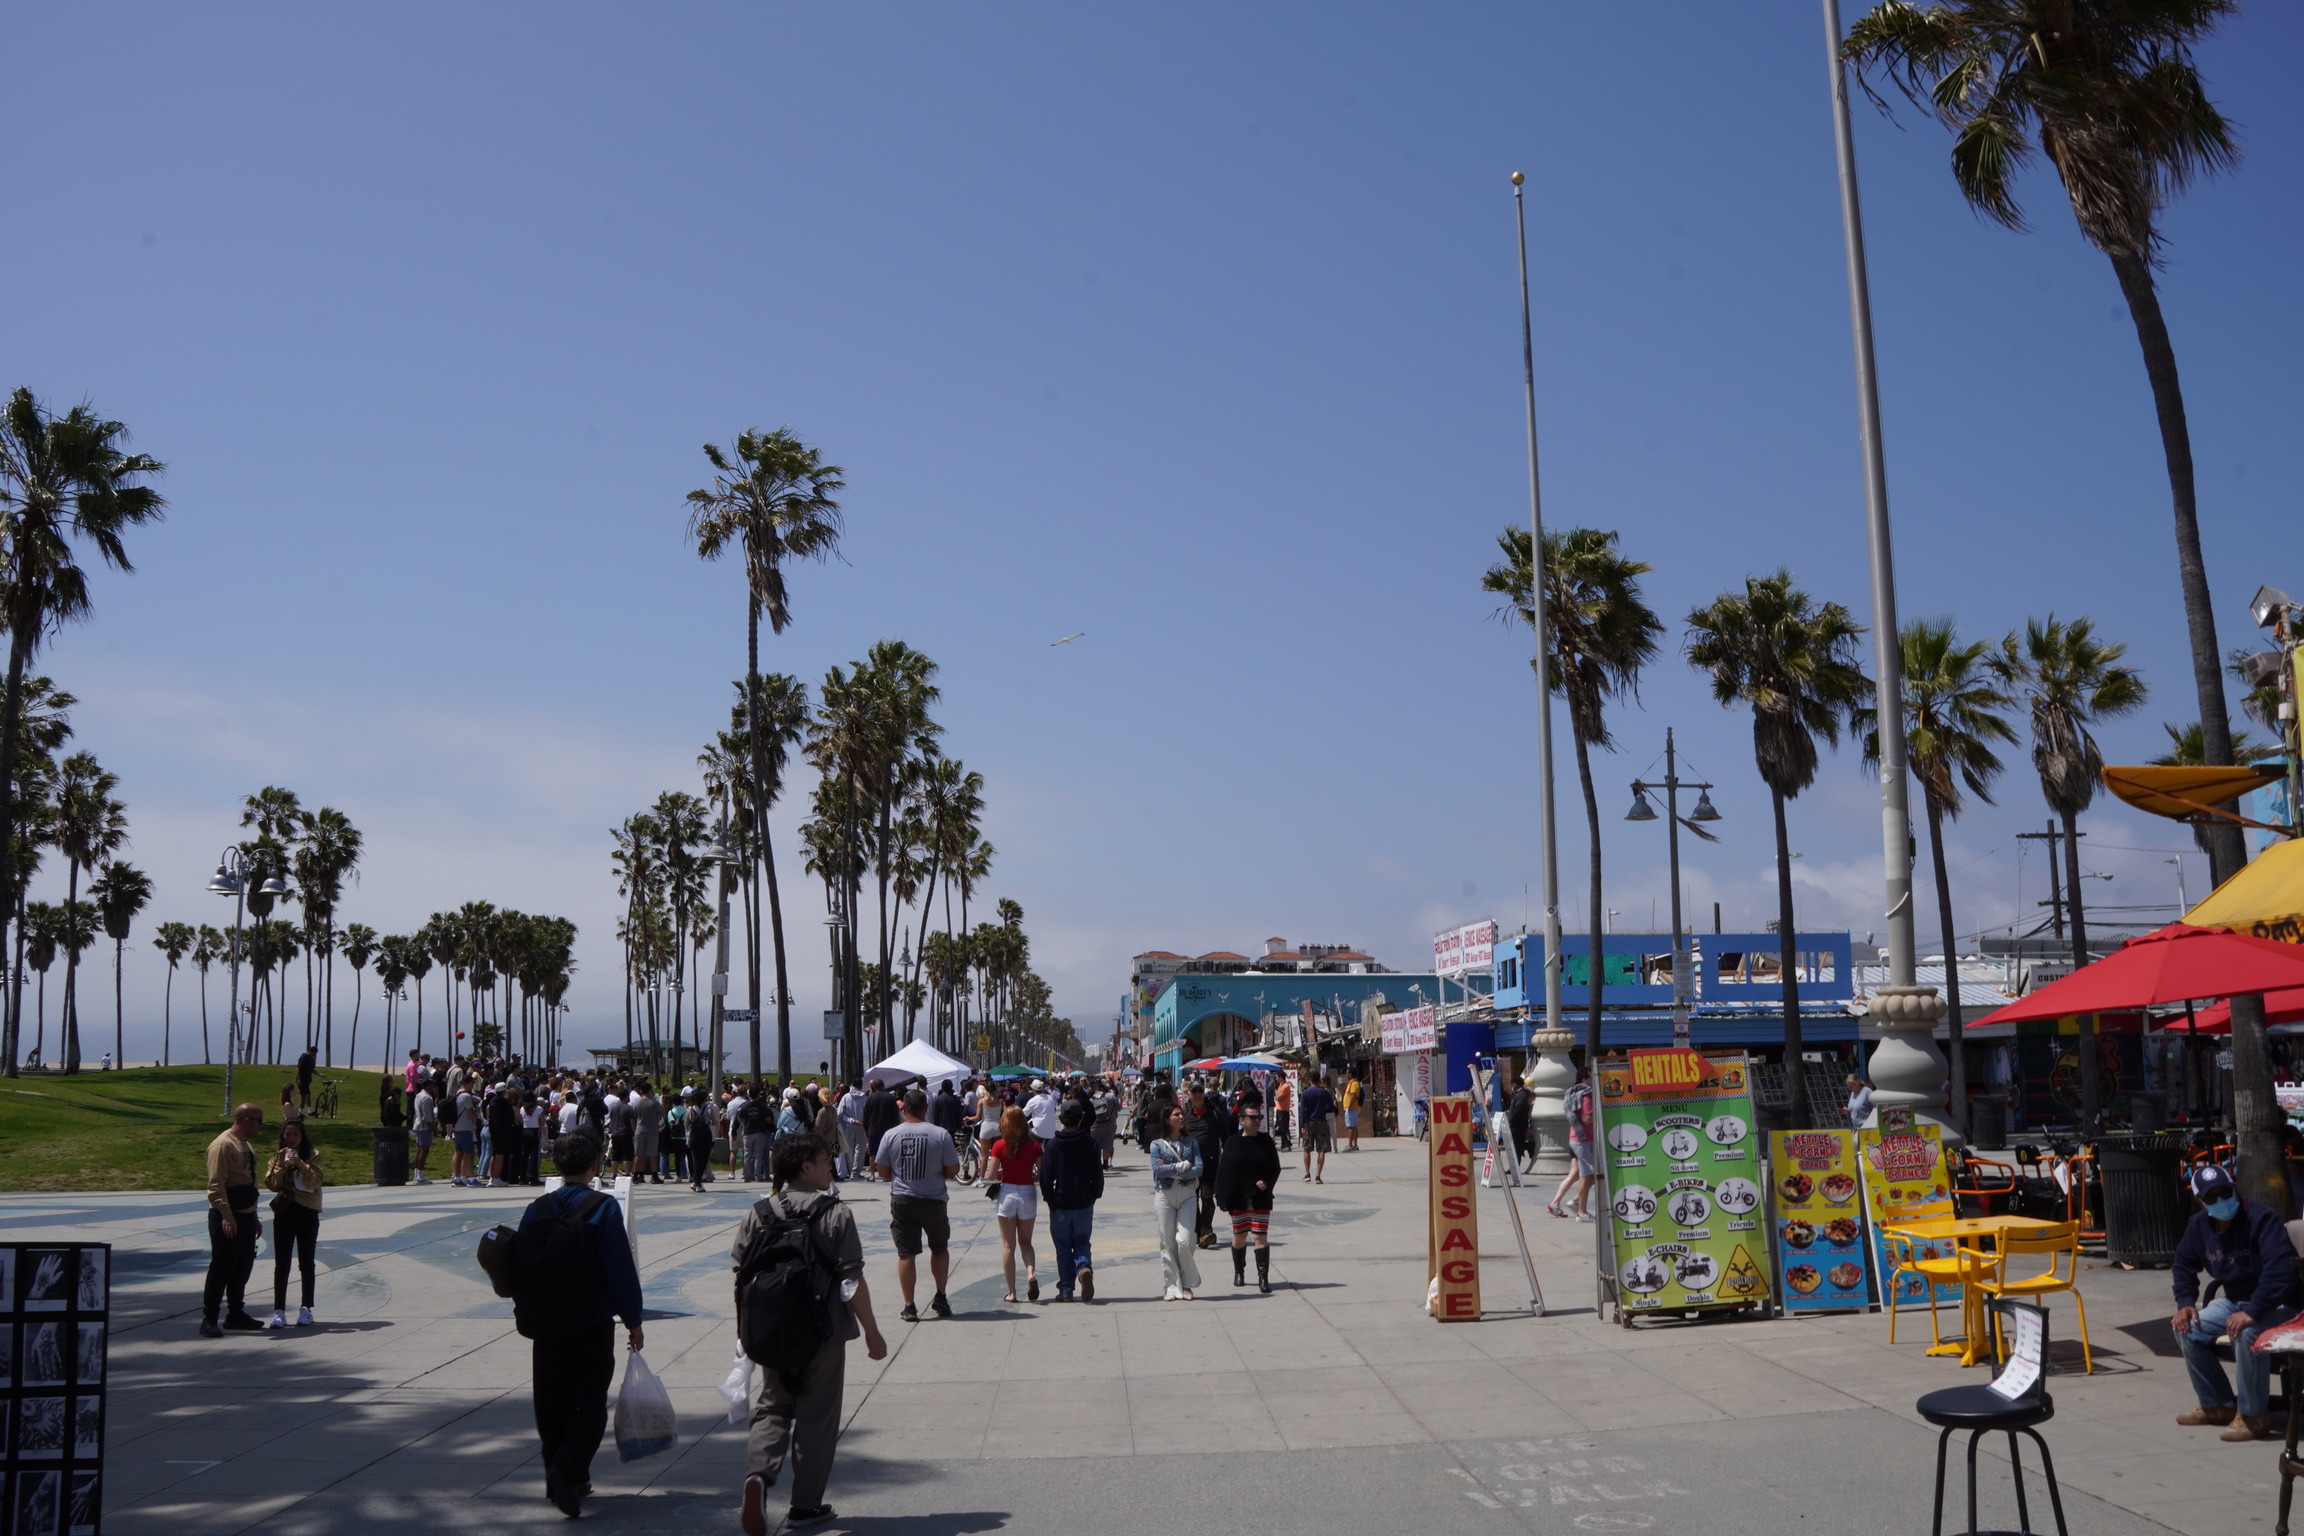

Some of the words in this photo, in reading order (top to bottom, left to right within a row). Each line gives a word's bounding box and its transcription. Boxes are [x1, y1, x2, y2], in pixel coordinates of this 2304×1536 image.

[2038, 974, 2067, 982] CUST
[1633, 1053, 1700, 1085] RENTALS
[1415, 1048, 1430, 1102] MASSA
[1662, 1104, 1687, 1113] MENU
[1656, 1117, 1700, 1127] SCOOTERS
[1794, 1134, 1830, 1148] KETTLE
[1882, 1134, 1924, 1154] KETTLE
[1714, 1151, 1744, 1159] Premium
[1800, 1147, 1827, 1157] CORN
[1800, 1161, 1830, 1169] CORNER
[1890, 1154, 1922, 1167] CORN
[1888, 1168, 1927, 1180] CORNER
[1669, 1178, 1704, 1189] E-BIKES
[1433, 1102, 1475, 1316] MASSAGE
[1728, 1221, 1755, 1229] Tricycle
[1625, 1228, 1652, 1238] Regular
[1678, 1230, 1709, 1239] Premium
[1648, 1244, 1688, 1256] E-CHAIRS
[1635, 1299, 1657, 1307] Single
[1687, 1294, 1710, 1302] Double
